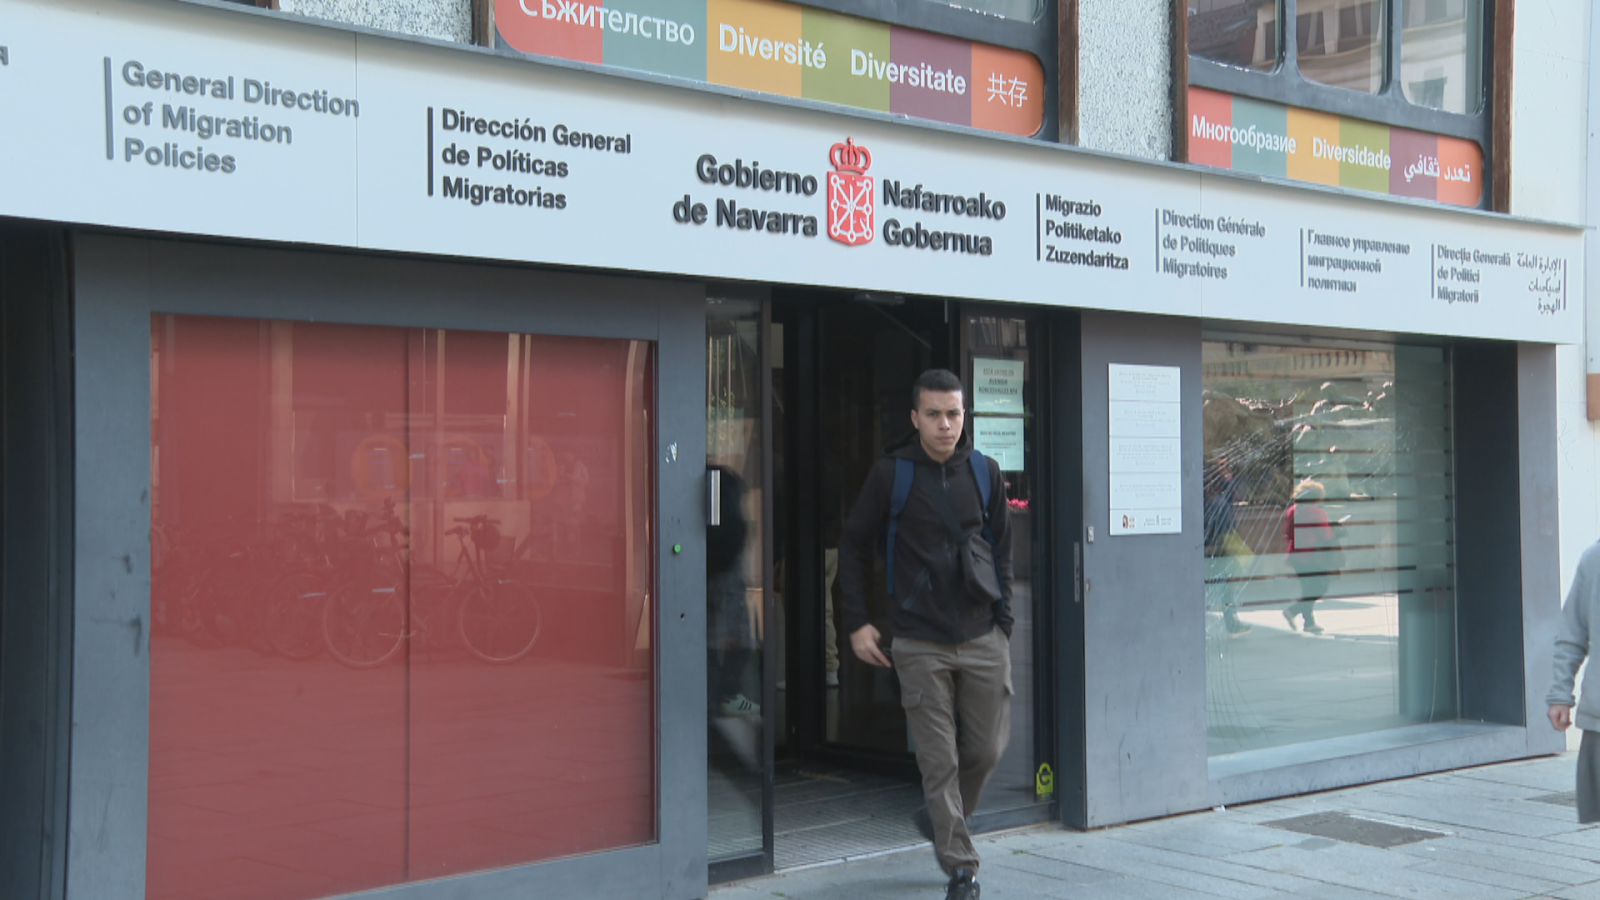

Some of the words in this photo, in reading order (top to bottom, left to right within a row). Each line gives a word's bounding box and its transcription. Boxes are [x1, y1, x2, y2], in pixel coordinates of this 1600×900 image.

[718, 23, 827, 69] Diversité
[122, 60, 235, 100] General
[243, 78, 360, 117] Direction
[850, 49, 967, 95] Diversitate
[986, 72, 1028, 107] 共存
[123, 102, 153, 126] of
[162, 104, 293, 144] Migration
[442, 107, 546, 142] Dirección
[552, 124, 631, 154] General
[1192, 114, 1297, 154] Многообразие
[124, 137, 236, 173] Policies
[442, 143, 470, 166] de
[477, 146, 569, 177] Políticas
[1312, 136, 1392, 170] Diversidade
[1403, 154, 1441, 183] ثقافي
[696, 154, 818, 196] Gobierno
[1443, 164, 1471, 183] تعدد
[442, 176, 567, 210] Migratorias
[882, 179, 1006, 220] Nafarroako
[1045, 193, 1102, 217] Migrazio
[672, 195, 708, 224] de
[716, 198, 818, 236] Navarra
[1045, 219, 1122, 244] Politiketako
[1162, 209, 1214, 231] Direction
[1217, 215, 1266, 237] Générale
[883, 219, 993, 256] Gobernua
[1162, 234, 1178, 250] de
[1180, 235, 1236, 257] Politiques
[1308, 229, 1351, 249] Главное
[1352, 237, 1411, 255] управление
[1045, 245, 1129, 270] Zuzendaritza
[1162, 257, 1228, 279] Migratoires
[1308, 254, 1382, 274] миграционной
[1437, 265, 1449, 280] de
[1450, 266, 1480, 284] Politici
[1473, 249, 1511, 267] Generală
[1308, 277, 1357, 293] политики
[1437, 286, 1480, 305] Migratorii
